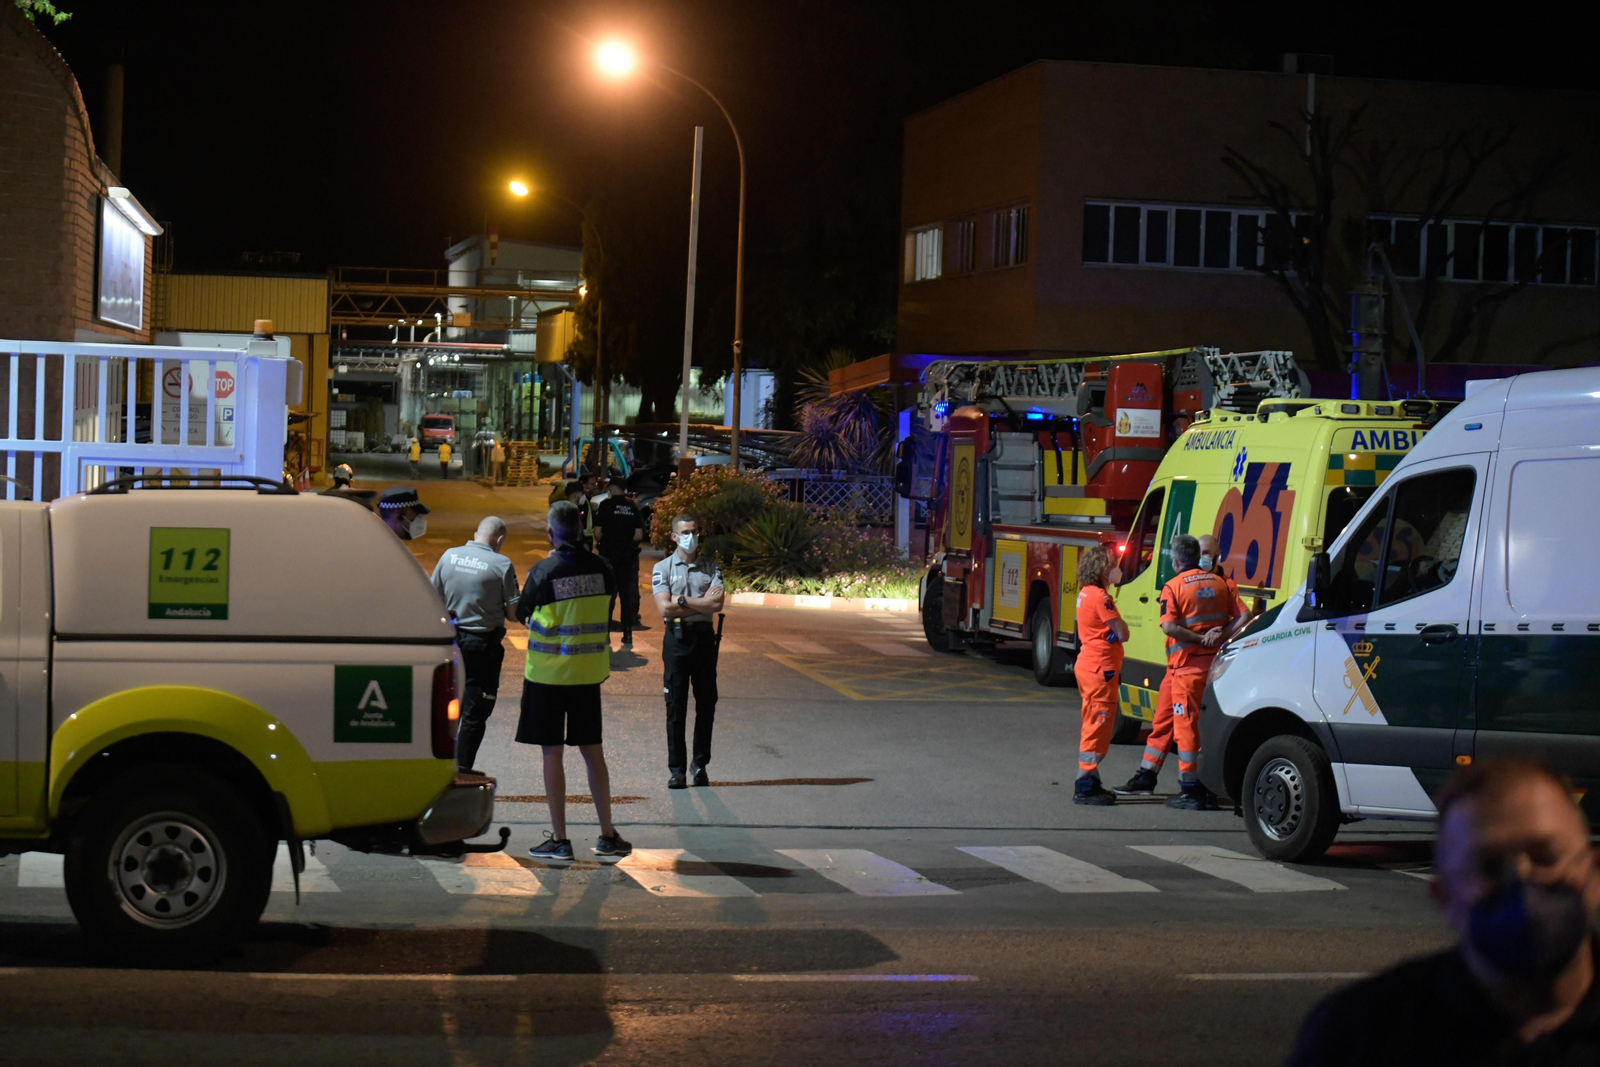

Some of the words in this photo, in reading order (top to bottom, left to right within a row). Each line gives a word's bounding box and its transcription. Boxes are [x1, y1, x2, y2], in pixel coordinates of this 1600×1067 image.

[214, 378, 234, 391] TOP
[224, 408, 233, 420] P
[1183, 430, 1237, 451] AMBULANCIA
[1212, 462, 1296, 589] 061
[160, 547, 221, 571] 112
[449, 553, 489, 571] Trablisa
[158, 574, 219, 585] Emergencias
[1007, 568, 1019, 586] 112
[1261, 630, 1293, 644] GUARDIA
[1294, 626, 1312, 637] CIVIL
